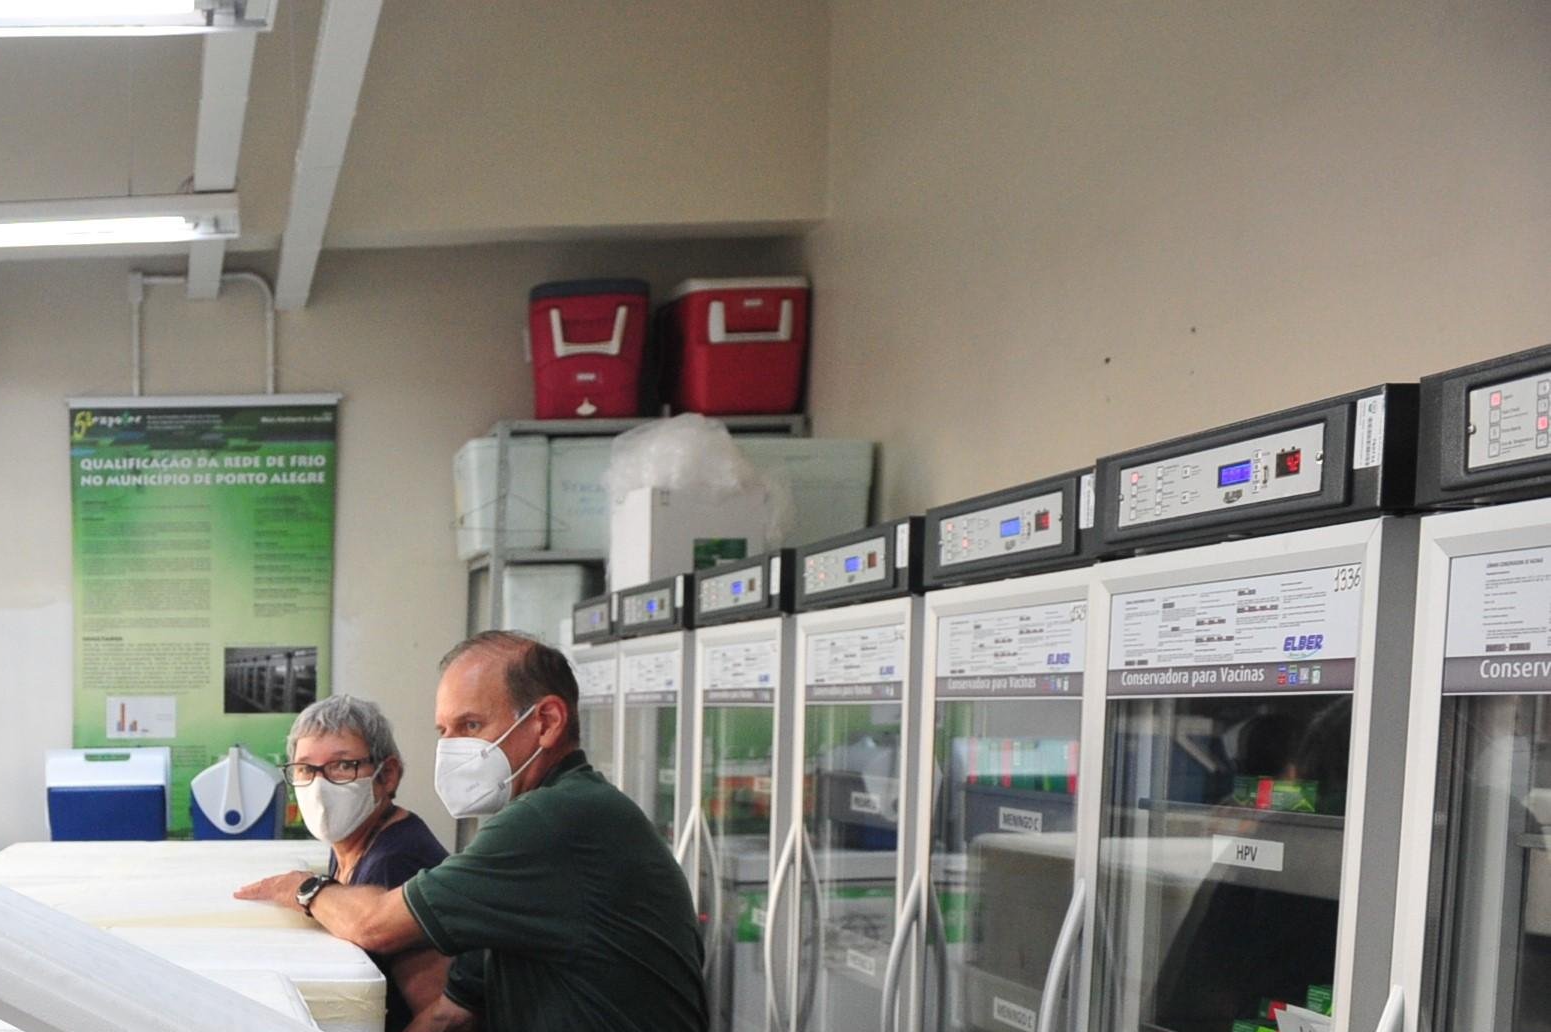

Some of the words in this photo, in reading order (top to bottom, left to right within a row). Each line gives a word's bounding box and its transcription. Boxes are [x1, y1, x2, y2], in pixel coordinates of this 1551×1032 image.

[197, 456, 219, 469] DA
[224, 456, 260, 468] REDE
[266, 455, 285, 467] DE
[289, 454, 327, 468] FRIO
[80, 474, 104, 487] NO
[193, 474, 211, 486] DE
[215, 473, 267, 485] PORTO
[269, 471, 326, 484] ALEGRE
[1334, 566, 1361, 592] 1336
[1282, 634, 1323, 652] ELBER
[1121, 668, 1188, 686] Conservadora
[1192, 670, 1217, 687] para
[1220, 665, 1265, 682] Vacinas
[1236, 844, 1258, 862] HPV
